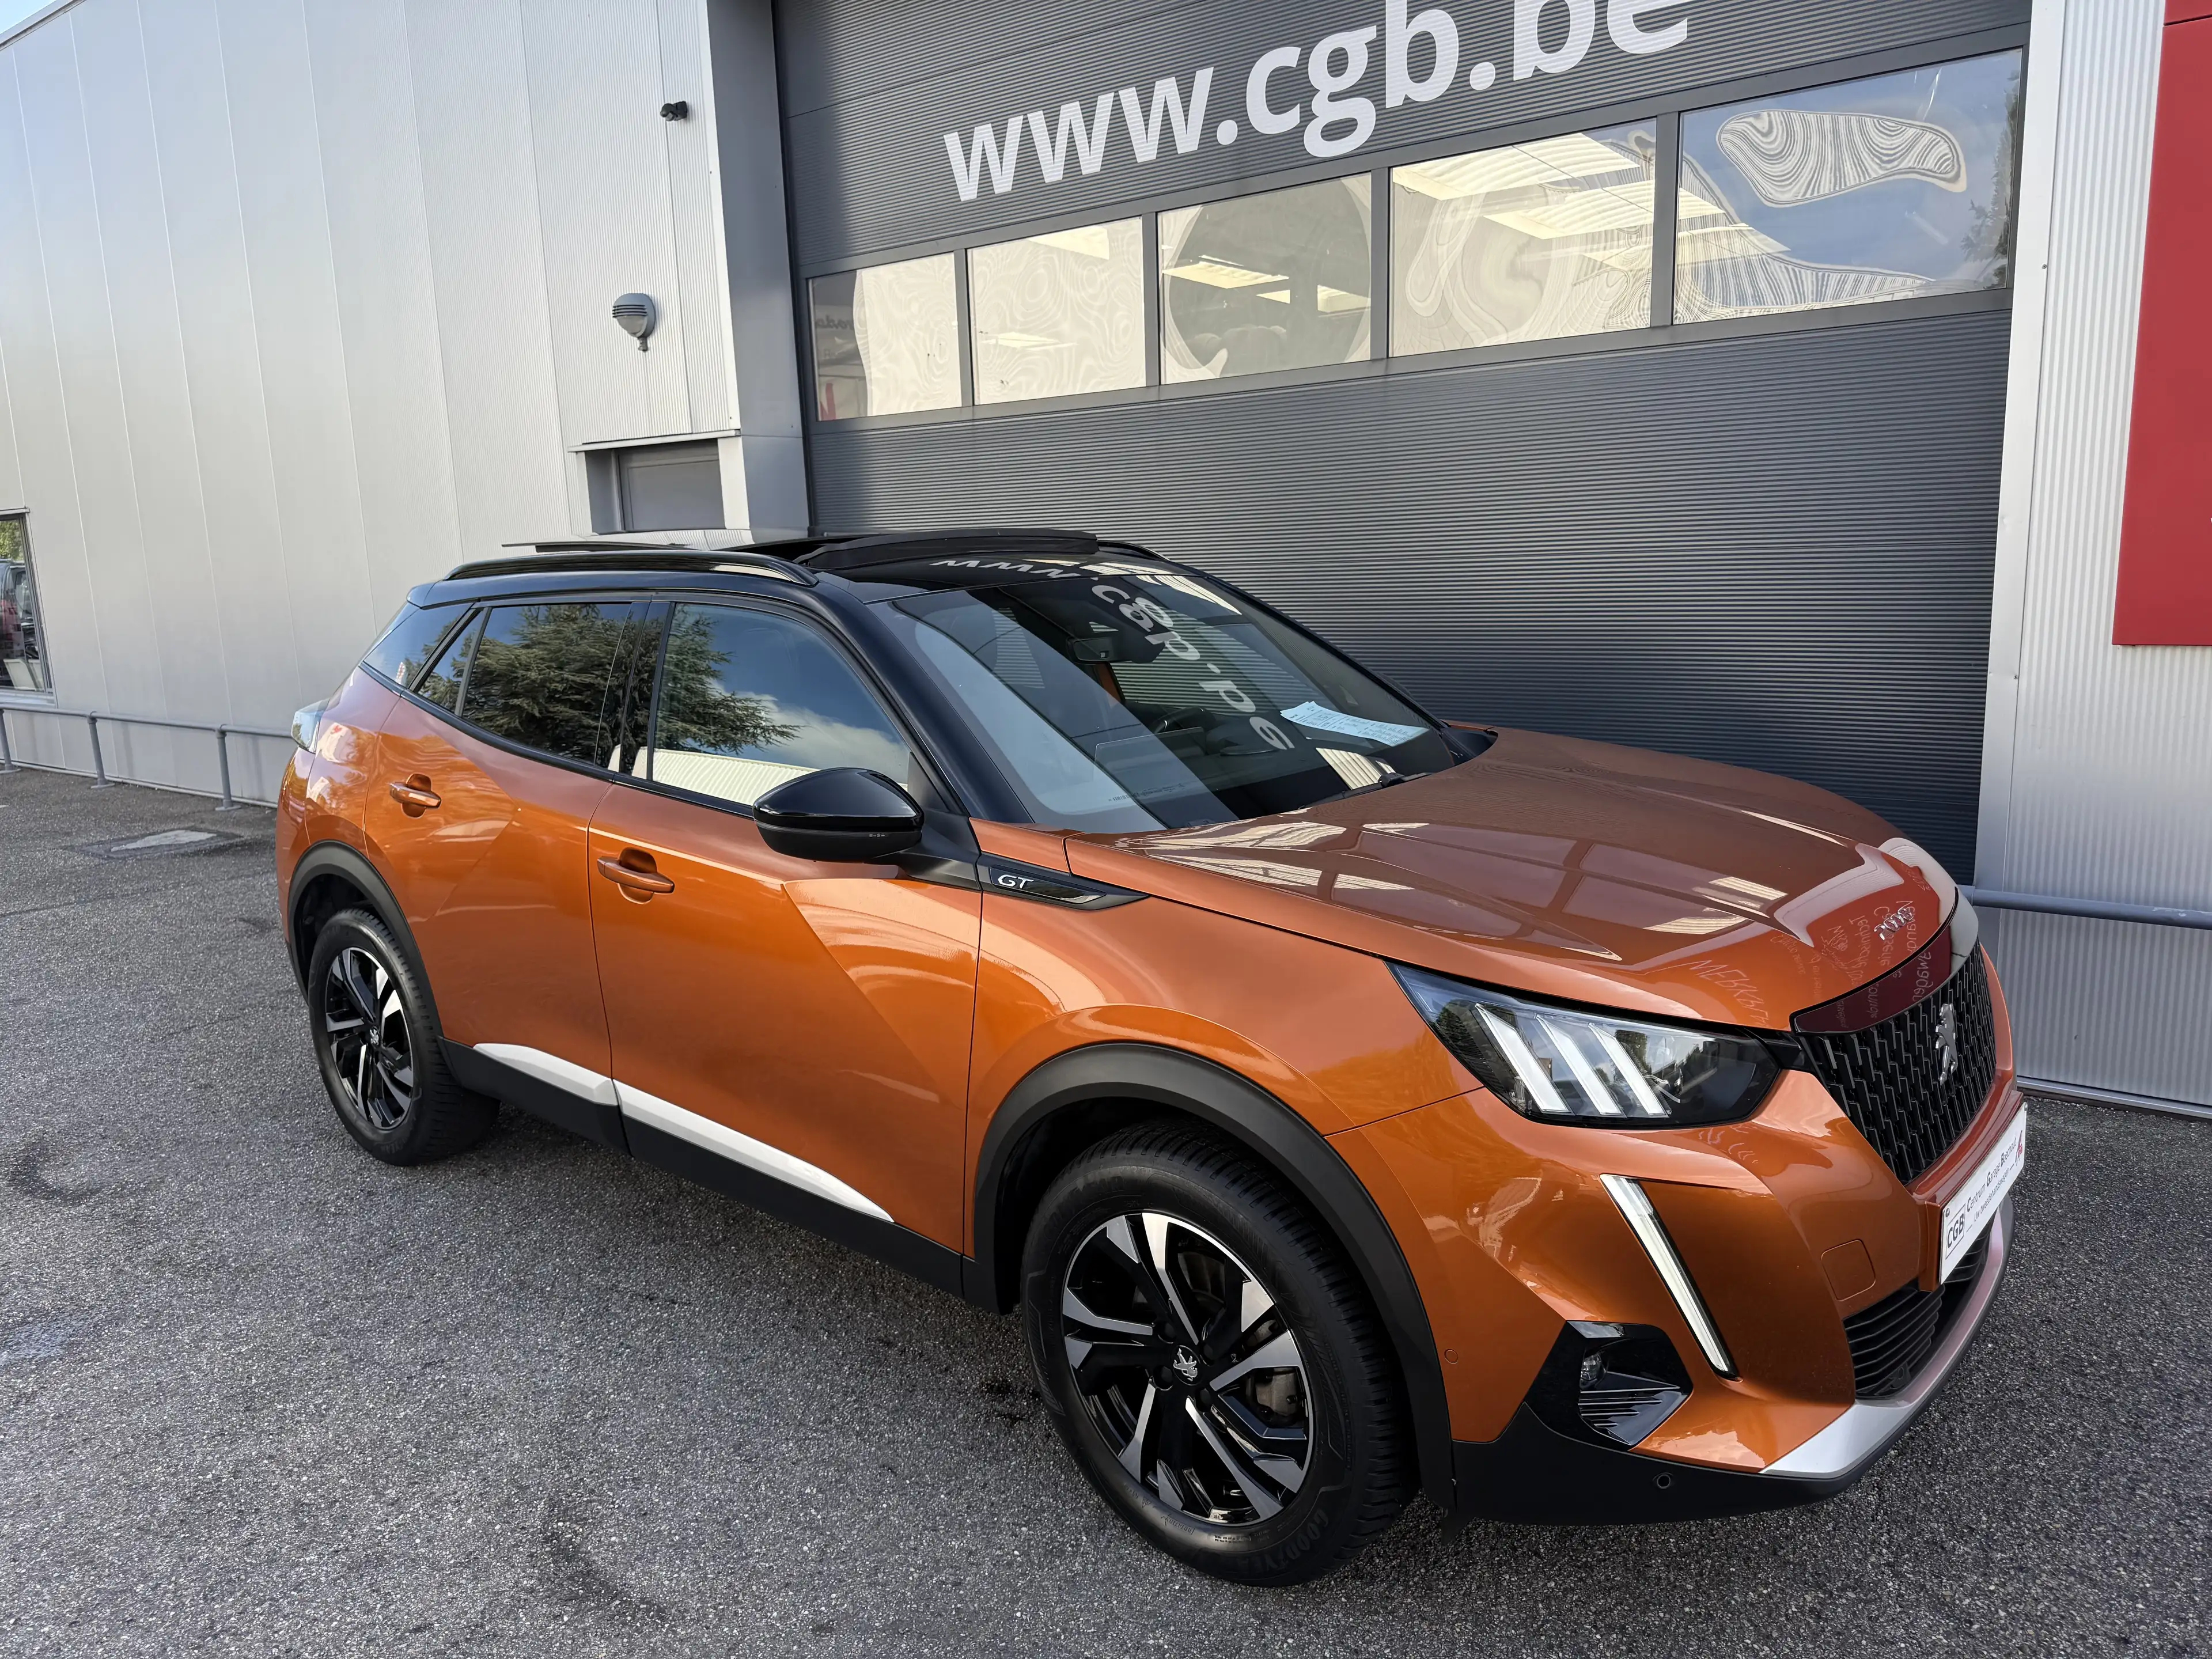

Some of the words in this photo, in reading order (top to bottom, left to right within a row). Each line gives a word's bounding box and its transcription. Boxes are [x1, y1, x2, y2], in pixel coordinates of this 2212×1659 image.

[944, 0, 1688, 202] www.cgb.be
[997, 874, 1035, 889] GT
[1967, 1183, 1986, 1212] Centrum
[1987, 1165, 2001, 1187] Garage
[1947, 1213, 1965, 1249] CGB
